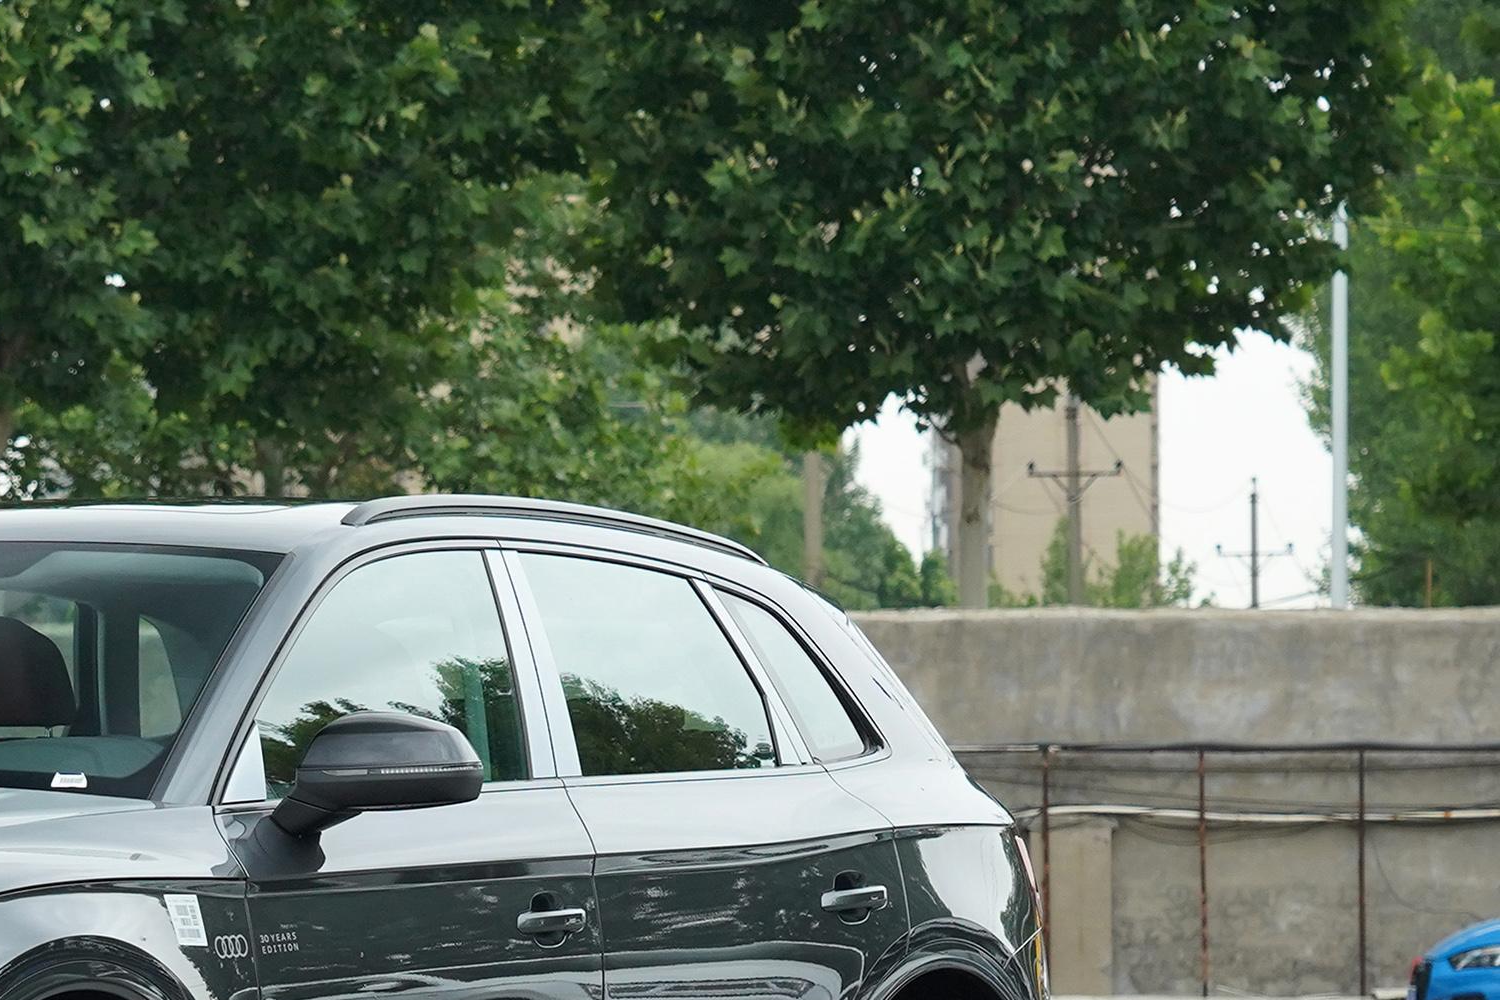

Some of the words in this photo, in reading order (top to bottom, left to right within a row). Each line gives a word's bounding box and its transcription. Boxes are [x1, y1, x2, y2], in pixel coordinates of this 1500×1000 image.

[259, 934, 270, 943] 30
[270, 931, 297, 943] YEARS
[261, 943, 299, 955] EDITION
